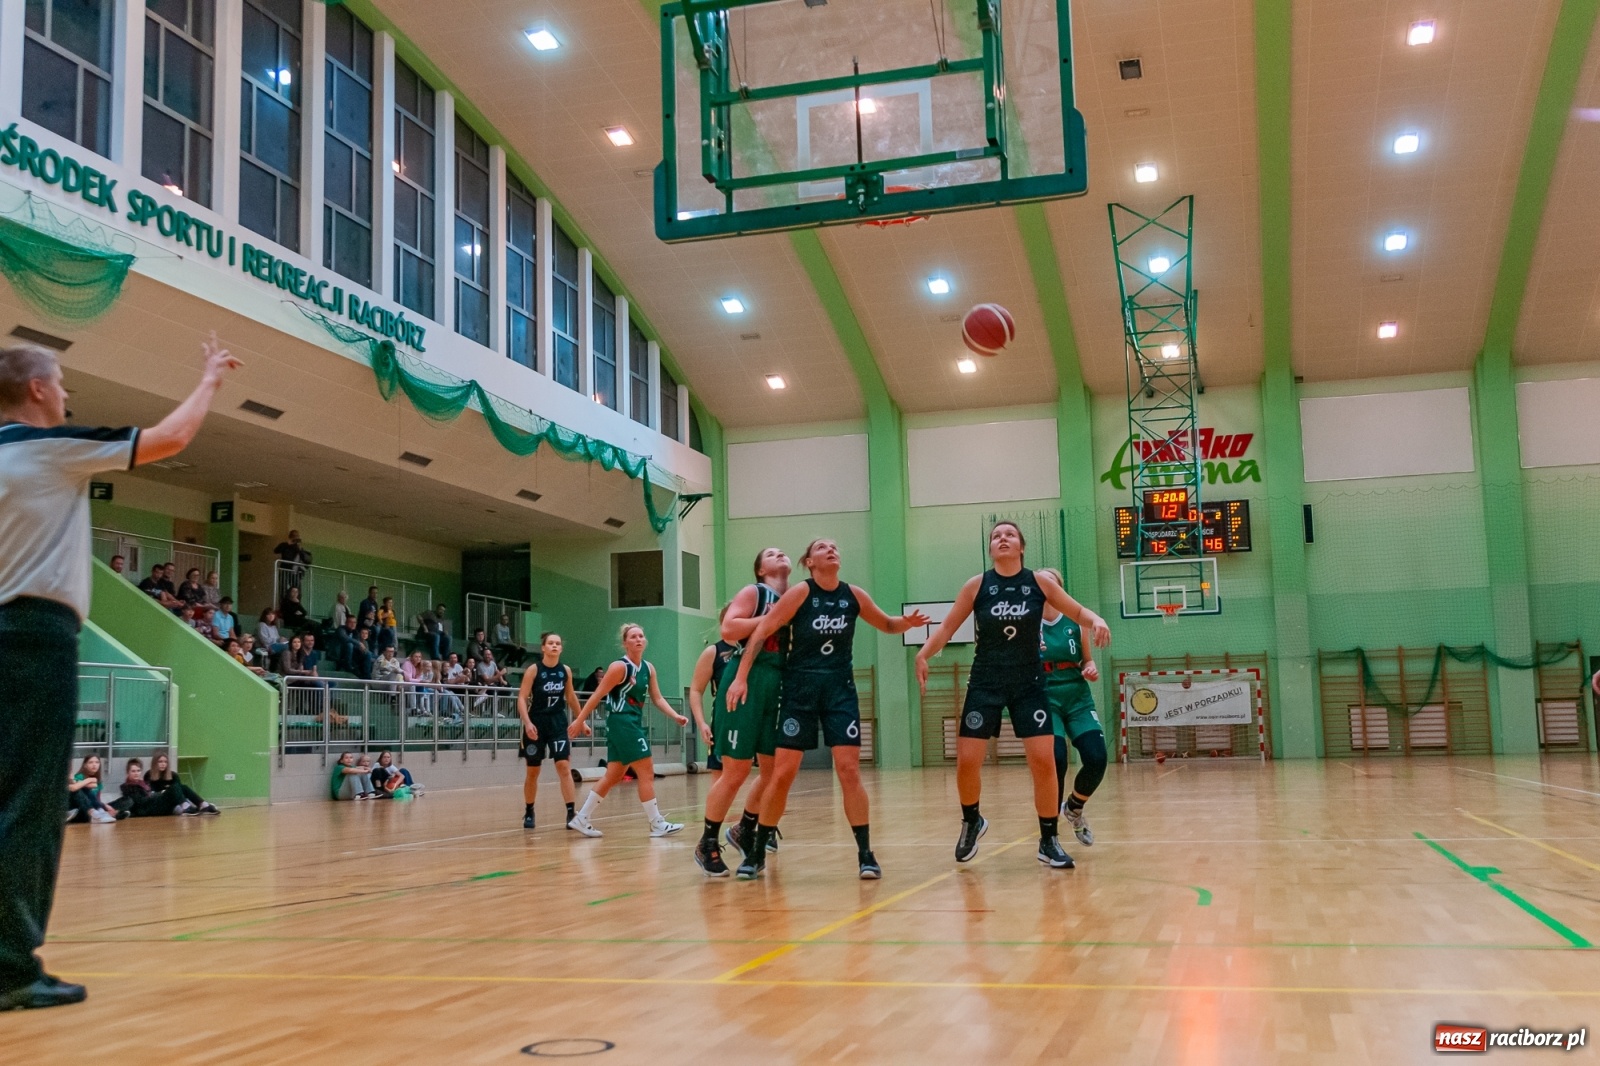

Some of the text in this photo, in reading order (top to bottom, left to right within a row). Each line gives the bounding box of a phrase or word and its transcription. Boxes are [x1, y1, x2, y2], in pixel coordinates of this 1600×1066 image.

[0, 122, 426, 352] ŚRODEK SPORTU I REKREACJI RACIBÓRZ
[93, 488, 106, 497] F
[216, 508, 227, 519] F
[1205, 538, 1222, 549] 46
[990, 600, 1029, 615] Stal
[812, 614, 847, 629] Stal
[1003, 625, 1016, 640] 9
[820, 639, 833, 654] 6
[1068, 638, 1076, 654] 8
[543, 681, 564, 691] Stal
[547, 696, 559, 707] 17
[1033, 709, 1046, 727] 9
[1164, 706, 1183, 719] JEST
[1184, 703, 1193, 711] W
[846, 720, 858, 738] 6
[553, 740, 566, 752] 17
[637, 737, 648, 751] 3
[727, 729, 738, 749] 4
